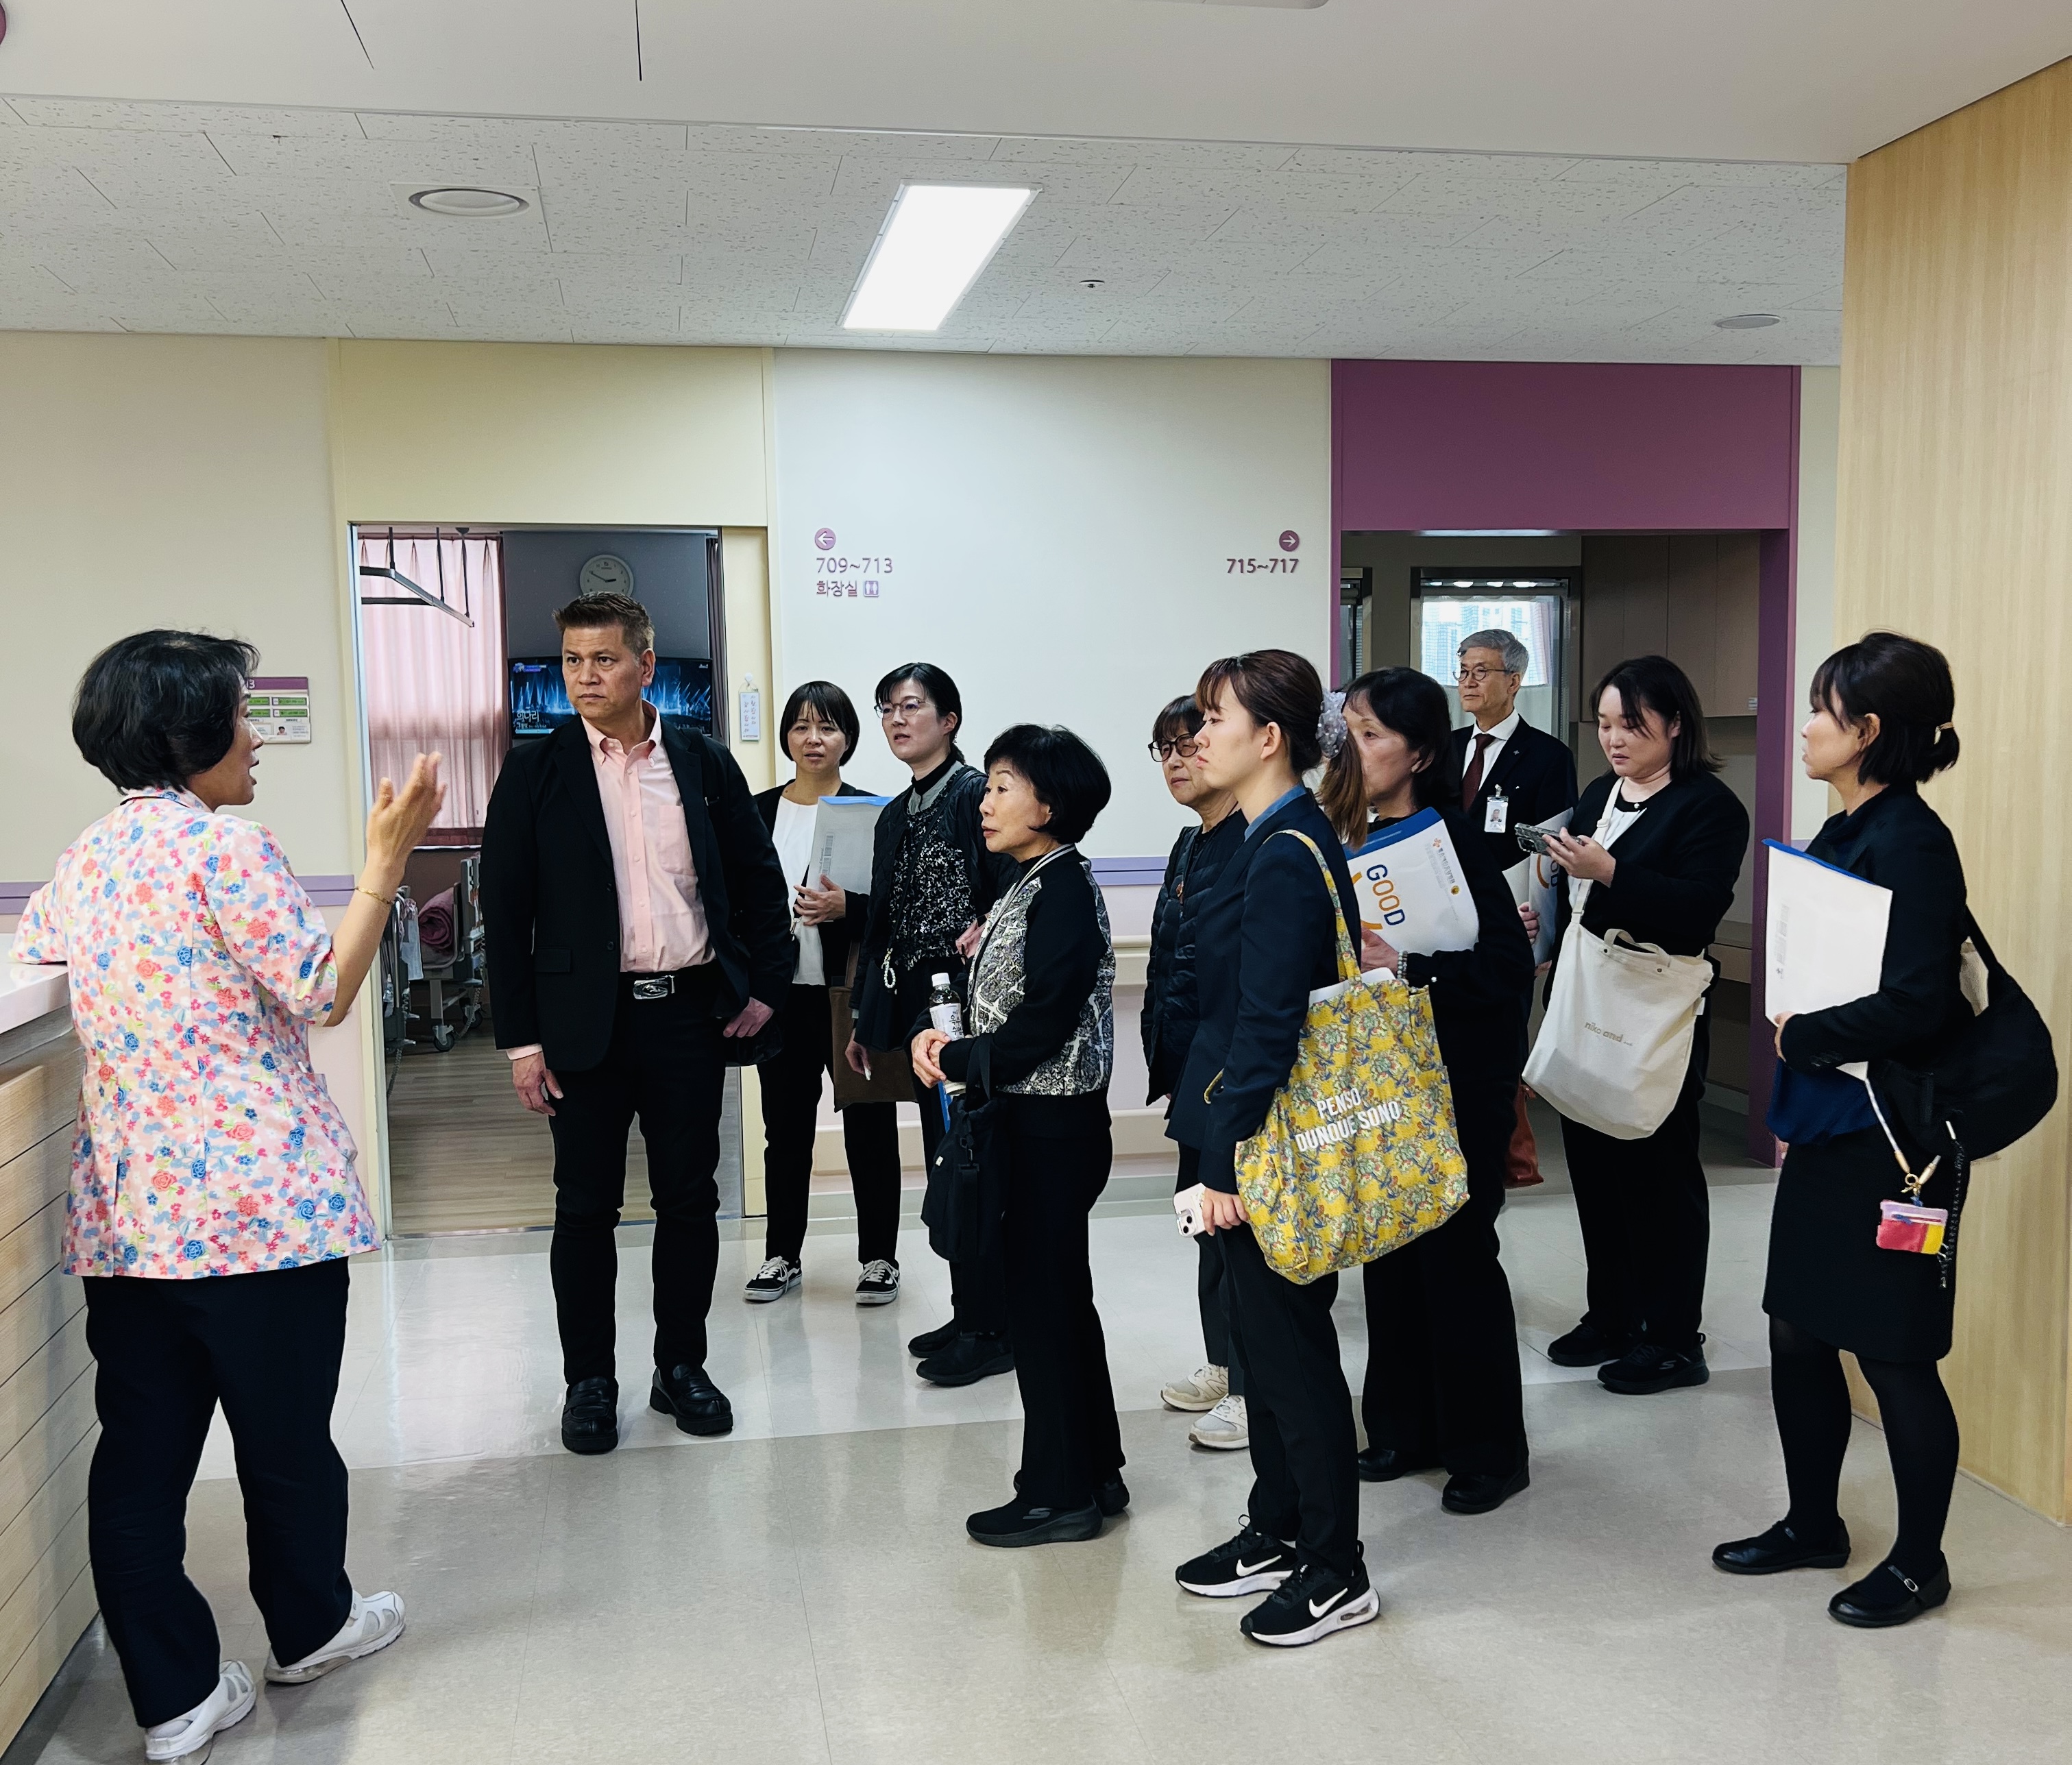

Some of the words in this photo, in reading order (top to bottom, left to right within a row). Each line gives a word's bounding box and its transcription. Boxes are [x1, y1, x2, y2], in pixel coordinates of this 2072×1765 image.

[816, 557, 893, 574] 709~713
[1226, 558, 1300, 574] 715~717
[816, 580, 858, 598] 화장실
[1367, 864, 1405, 926] GOOD
[1584, 1022, 1601, 1034] niko
[1317, 1087, 1362, 1119] PENSO
[1295, 1115, 1357, 1152] DUNQUE
[1358, 1101, 1401, 1130] SONO
